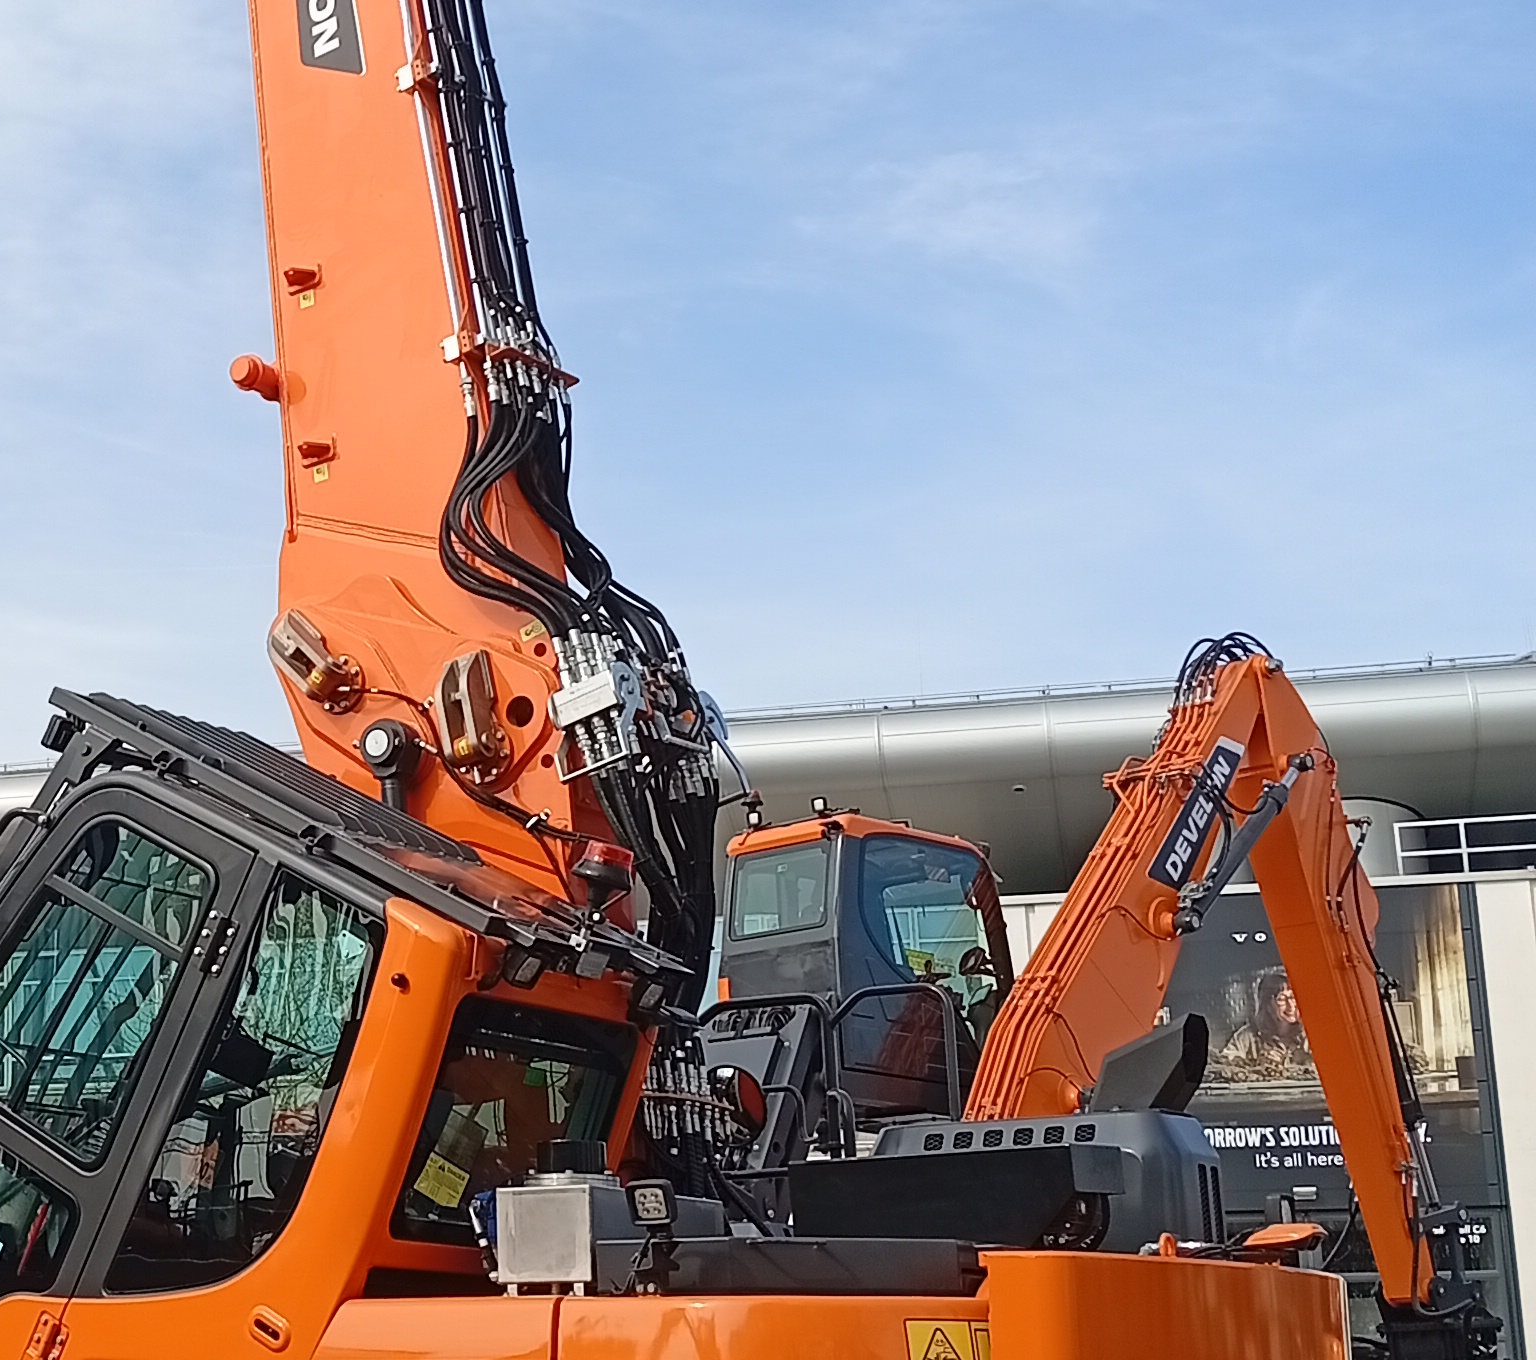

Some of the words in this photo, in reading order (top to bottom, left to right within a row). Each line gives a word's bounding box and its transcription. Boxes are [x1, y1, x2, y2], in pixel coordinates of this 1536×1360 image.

[1203, 1127, 1276, 1149] ORROW'S
[1280, 1125, 1341, 1148] SOLUTI
[1255, 1152, 1280, 1168] It's
[1284, 1152, 1302, 1168] all
